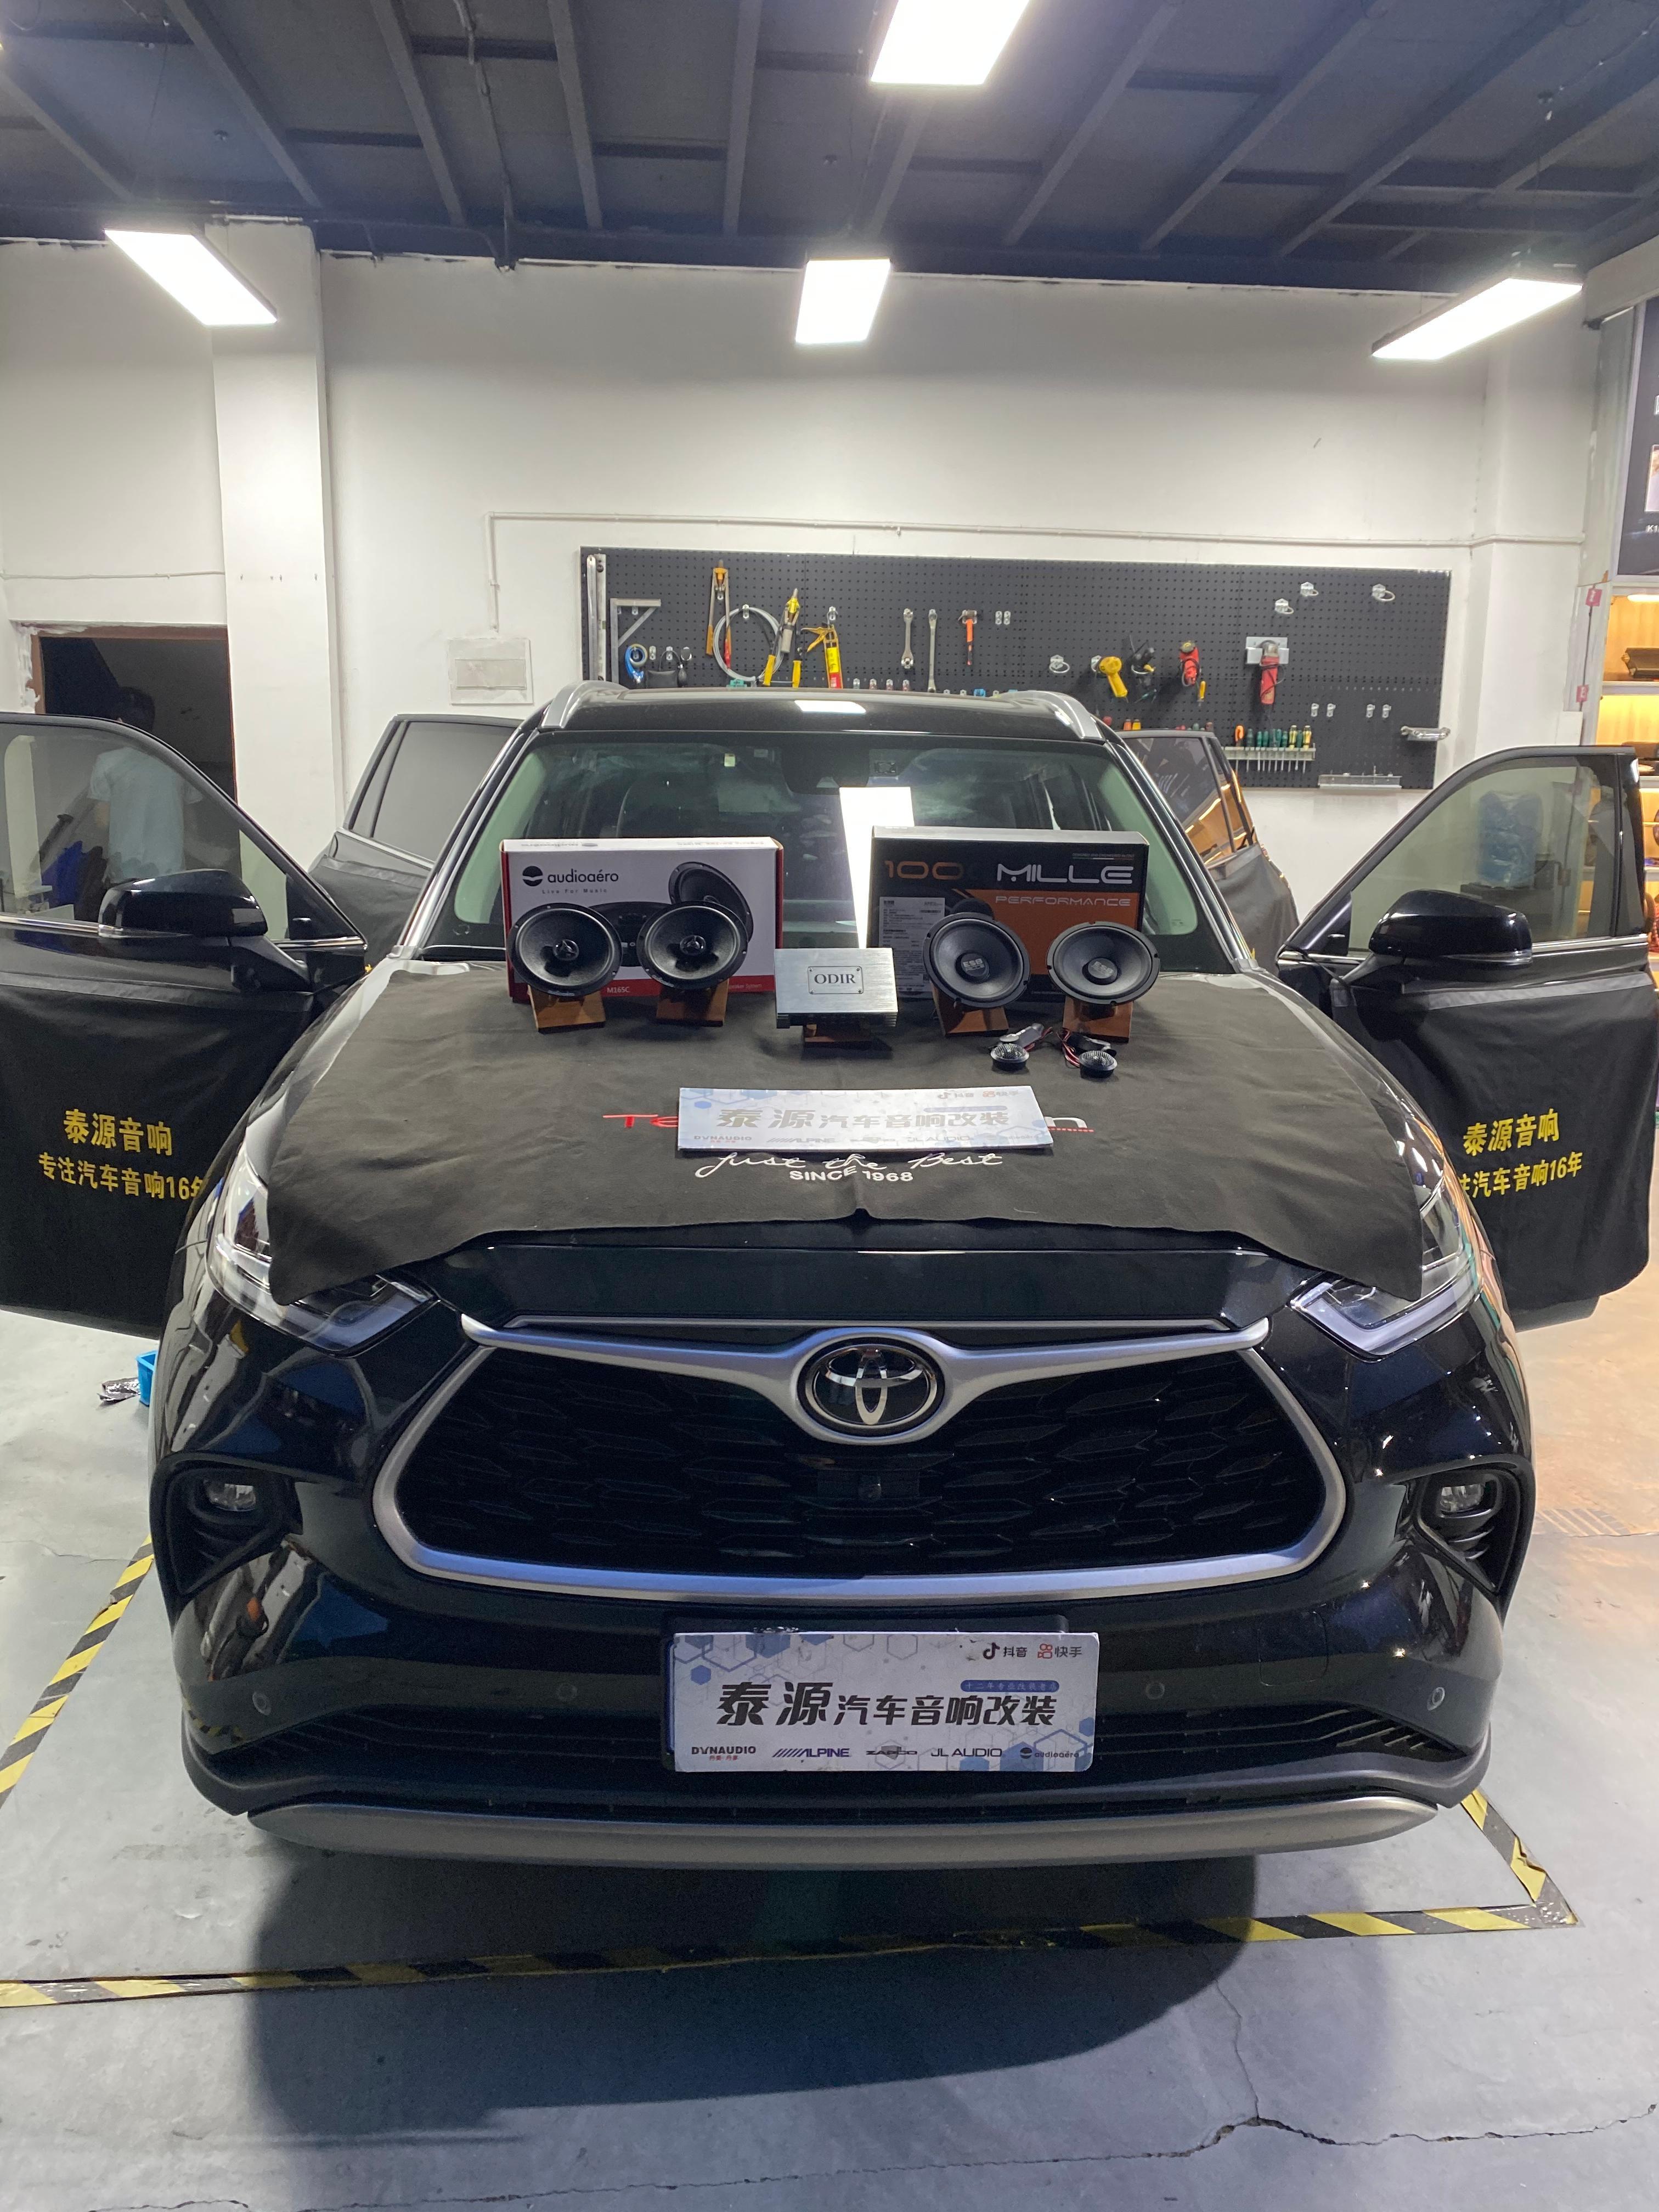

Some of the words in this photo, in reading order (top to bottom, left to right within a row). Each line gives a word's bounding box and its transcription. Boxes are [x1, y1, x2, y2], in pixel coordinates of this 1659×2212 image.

[548, 868, 619, 883] audioaéro
[997, 863, 1134, 884] MILLE
[995, 896, 1131, 906] PERFORMANCE
[962, 958, 983, 967] ESB
[814, 974, 856, 984] ODIR
[63, 1109, 172, 1155] 泰源音响
[1463, 1108, 1559, 1156] 泰源音响
[789, 1166, 857, 1181] SINCE
[862, 1170, 913, 1181] 1968
[1003, 1646, 1028, 1657] 抖音
[1054, 1646, 1082, 1658] 快手
[691, 1746, 757, 1754] DYNAUDIO
[796, 1748, 850, 1758] ALPINE
[931, 1748, 947, 1757] JL
[952, 1748, 1003, 1757] AUDIO
